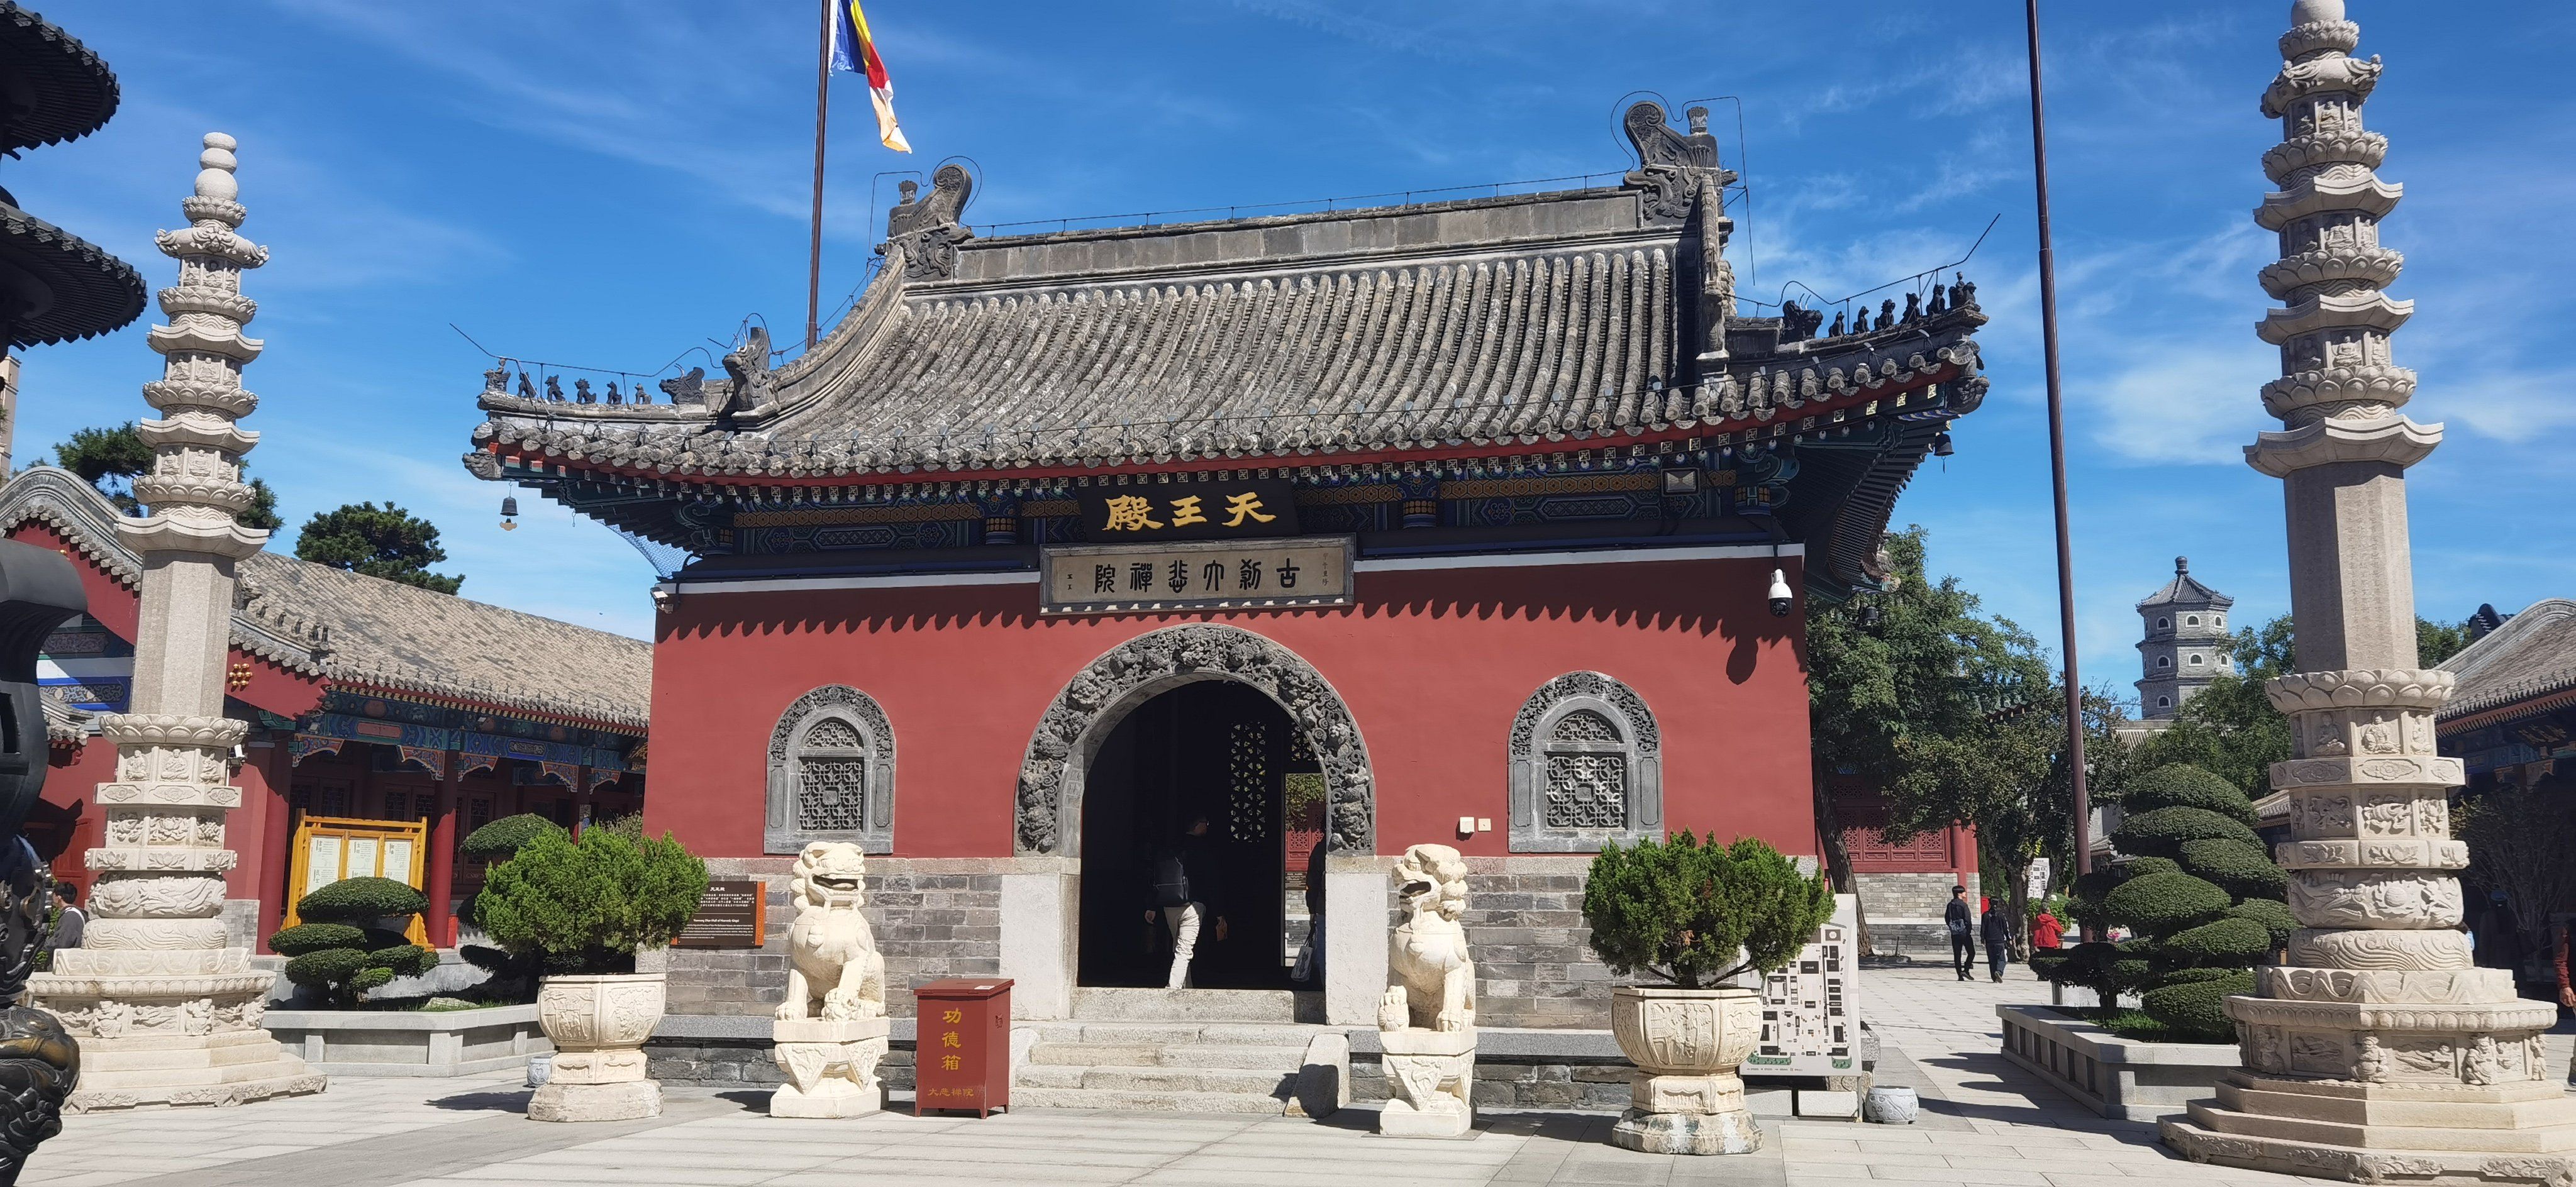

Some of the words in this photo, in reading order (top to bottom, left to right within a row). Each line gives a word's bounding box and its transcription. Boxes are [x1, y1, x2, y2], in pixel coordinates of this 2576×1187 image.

[1101, 492, 1277, 531] 天王殿
[941, 1007, 962, 1071] 功德箱
